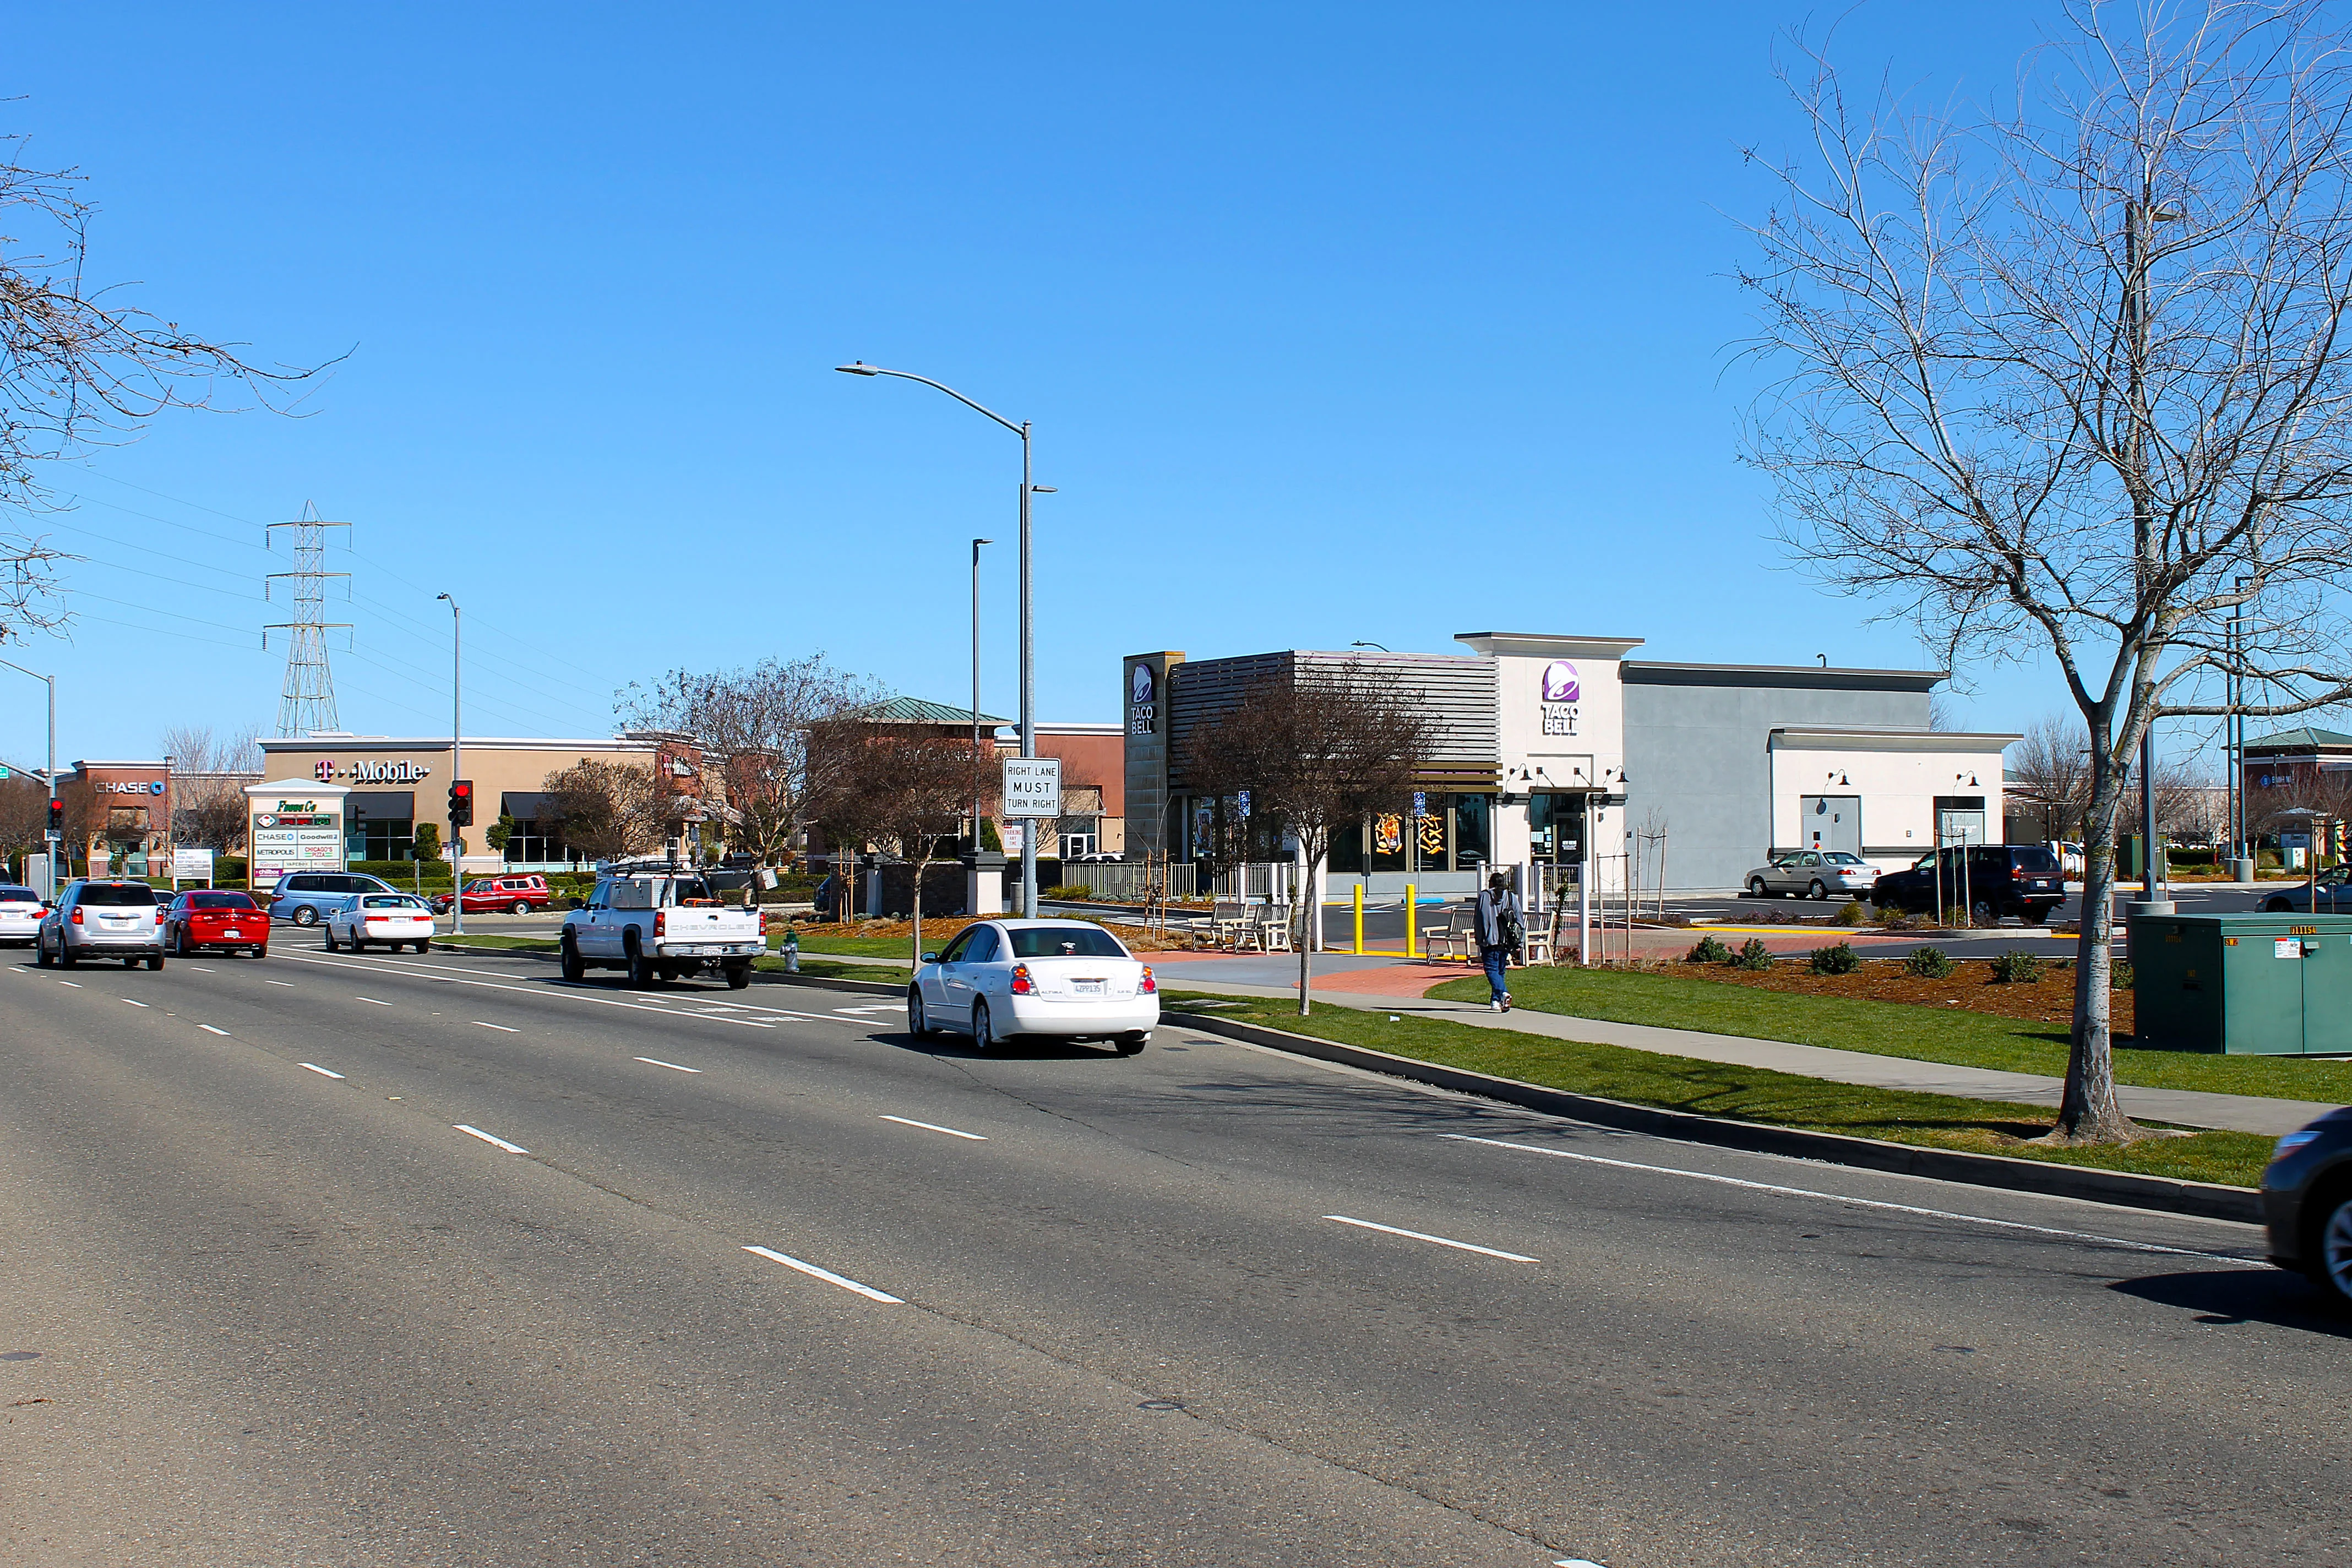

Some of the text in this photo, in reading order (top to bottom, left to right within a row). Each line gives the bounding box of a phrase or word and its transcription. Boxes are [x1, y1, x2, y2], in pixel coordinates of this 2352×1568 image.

[1131, 706, 1153, 721] TACO
[1542, 704, 1581, 719] TACO
[1132, 720, 1152, 734] BELL
[1544, 718, 1578, 734] BELL
[1008, 766, 1056, 776] RIGHT LANE
[95, 781, 149, 793] CHASE
[1014, 782, 1050, 793] MUST
[1008, 798, 1056, 809] TURN RIGHT
